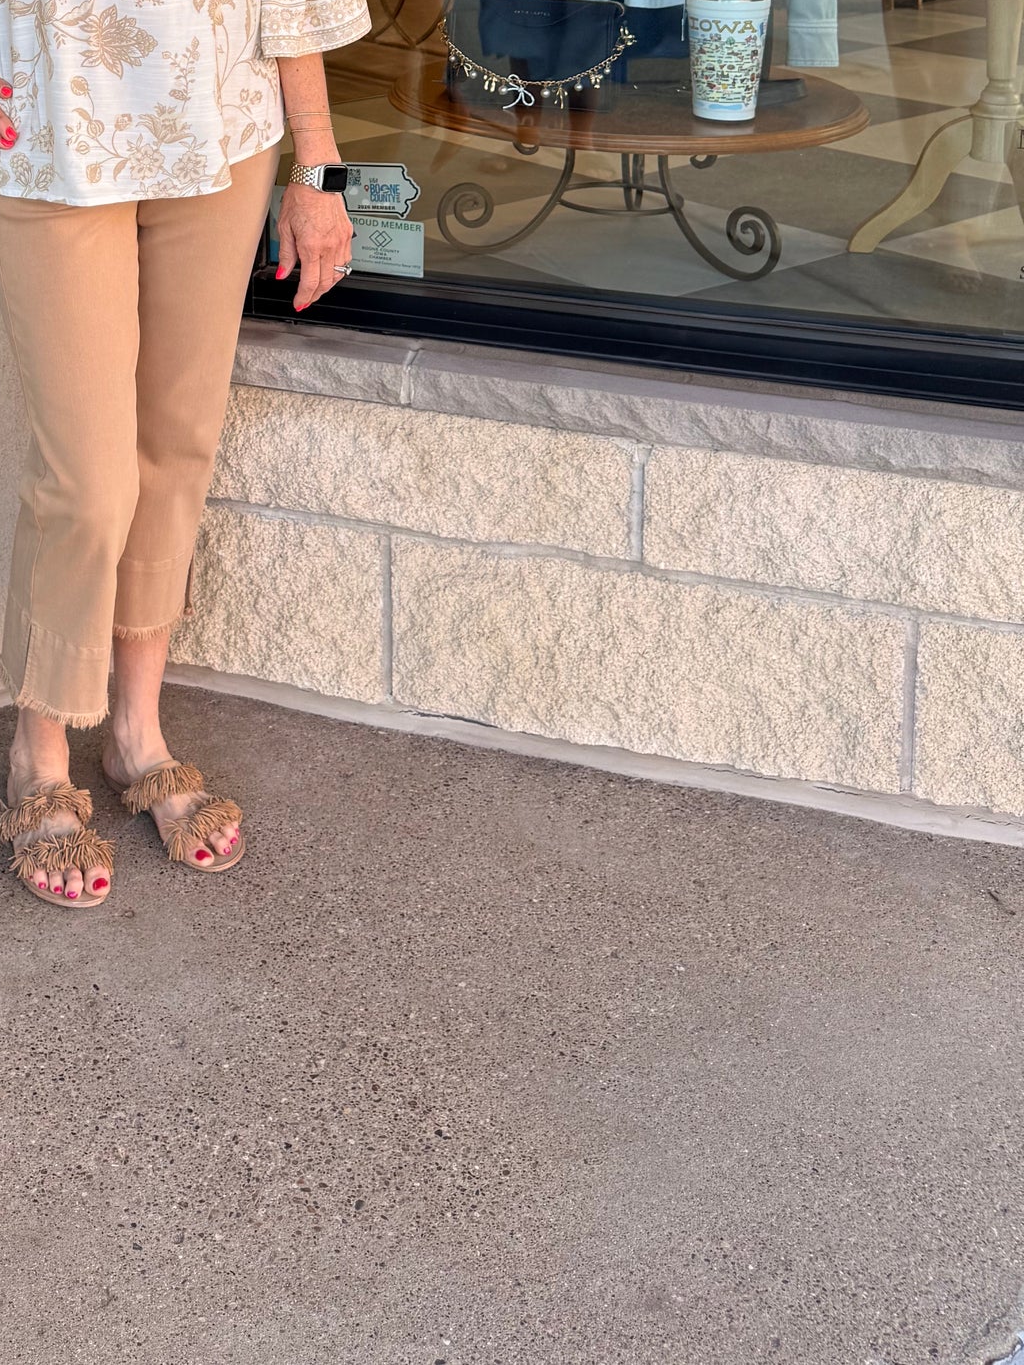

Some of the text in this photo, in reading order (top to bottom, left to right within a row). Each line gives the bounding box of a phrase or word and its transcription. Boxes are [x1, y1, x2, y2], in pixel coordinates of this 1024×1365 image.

[689, 16, 757, 34] IOWA
[370, 194, 396, 203] COUNTY
[381, 220, 422, 232] MEMBER
